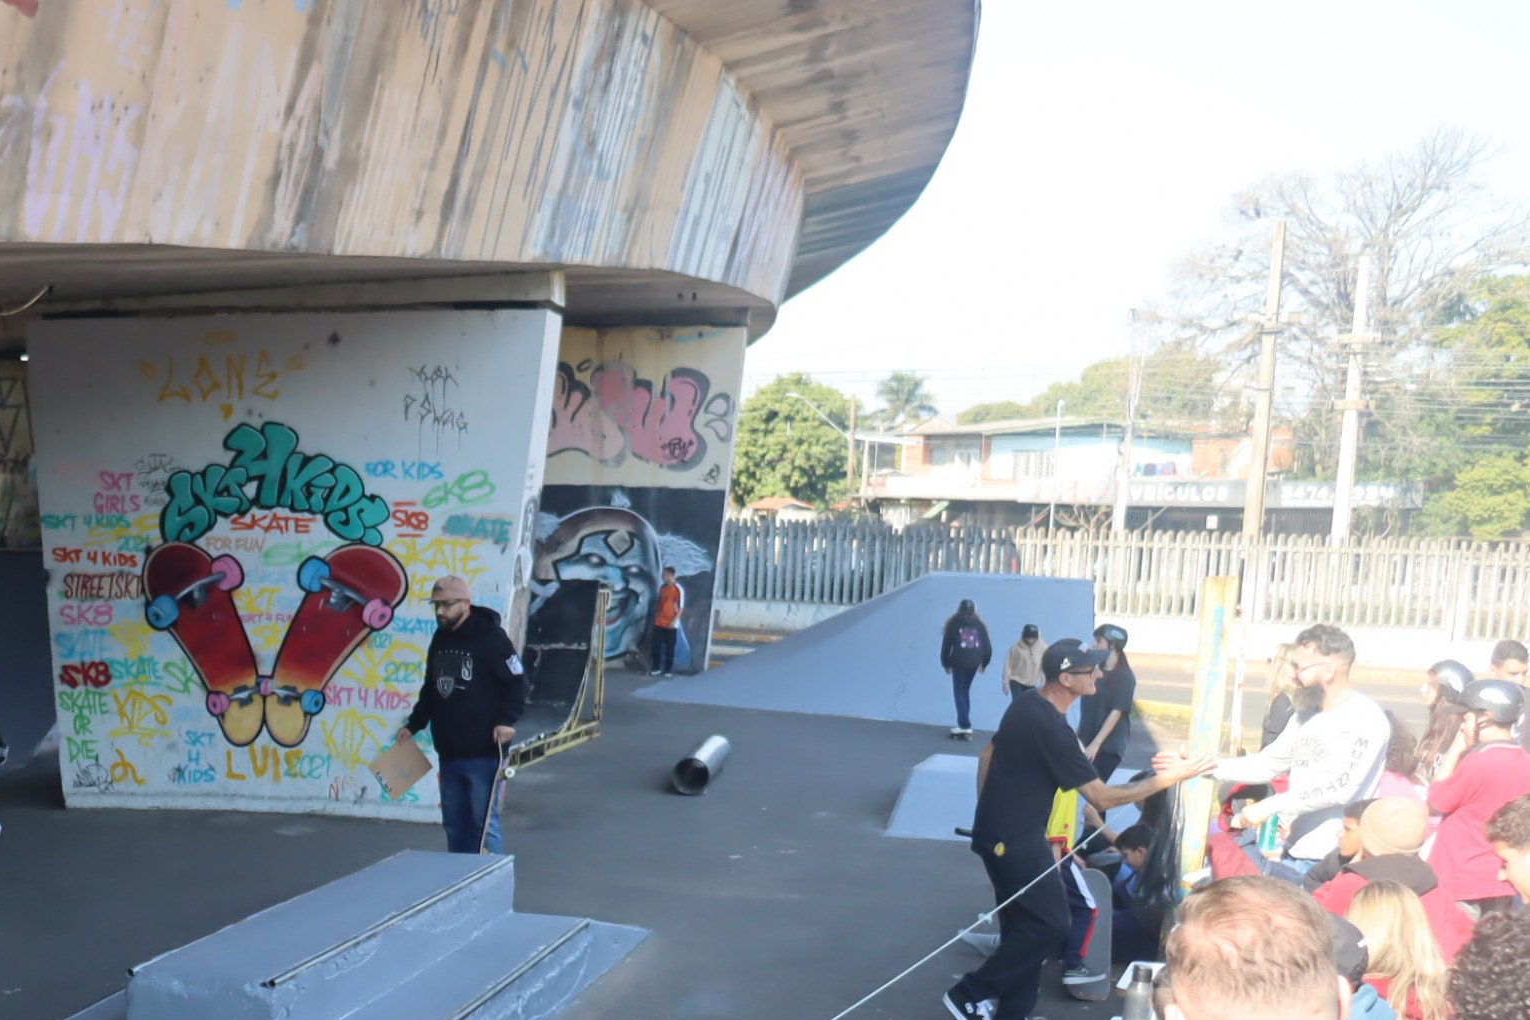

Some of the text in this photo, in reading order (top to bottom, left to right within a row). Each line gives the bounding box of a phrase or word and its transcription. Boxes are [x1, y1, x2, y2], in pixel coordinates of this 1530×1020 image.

[99, 470, 134, 492] SKT
[365, 460, 444, 481] FOR KIDS
[93, 492, 141, 515] GIRLS
[230, 513, 317, 535] SKATE
[391, 509, 431, 531] SK8
[206, 536, 231, 550] FOR
[52, 547, 83, 563] SKT
[87, 550, 98, 565] 4
[59, 604, 114, 626] SK8
[59, 661, 112, 689] SK8
[110, 656, 164, 681] SKATE
[58, 689, 110, 714] SKATE
[358, 689, 370, 708] 4
[374, 688, 414, 711] KIDS
[73, 715, 94, 736] OR
[186, 730, 215, 746] SKT
[188, 751, 199, 764] 4
[176, 766, 216, 783] KIDS
